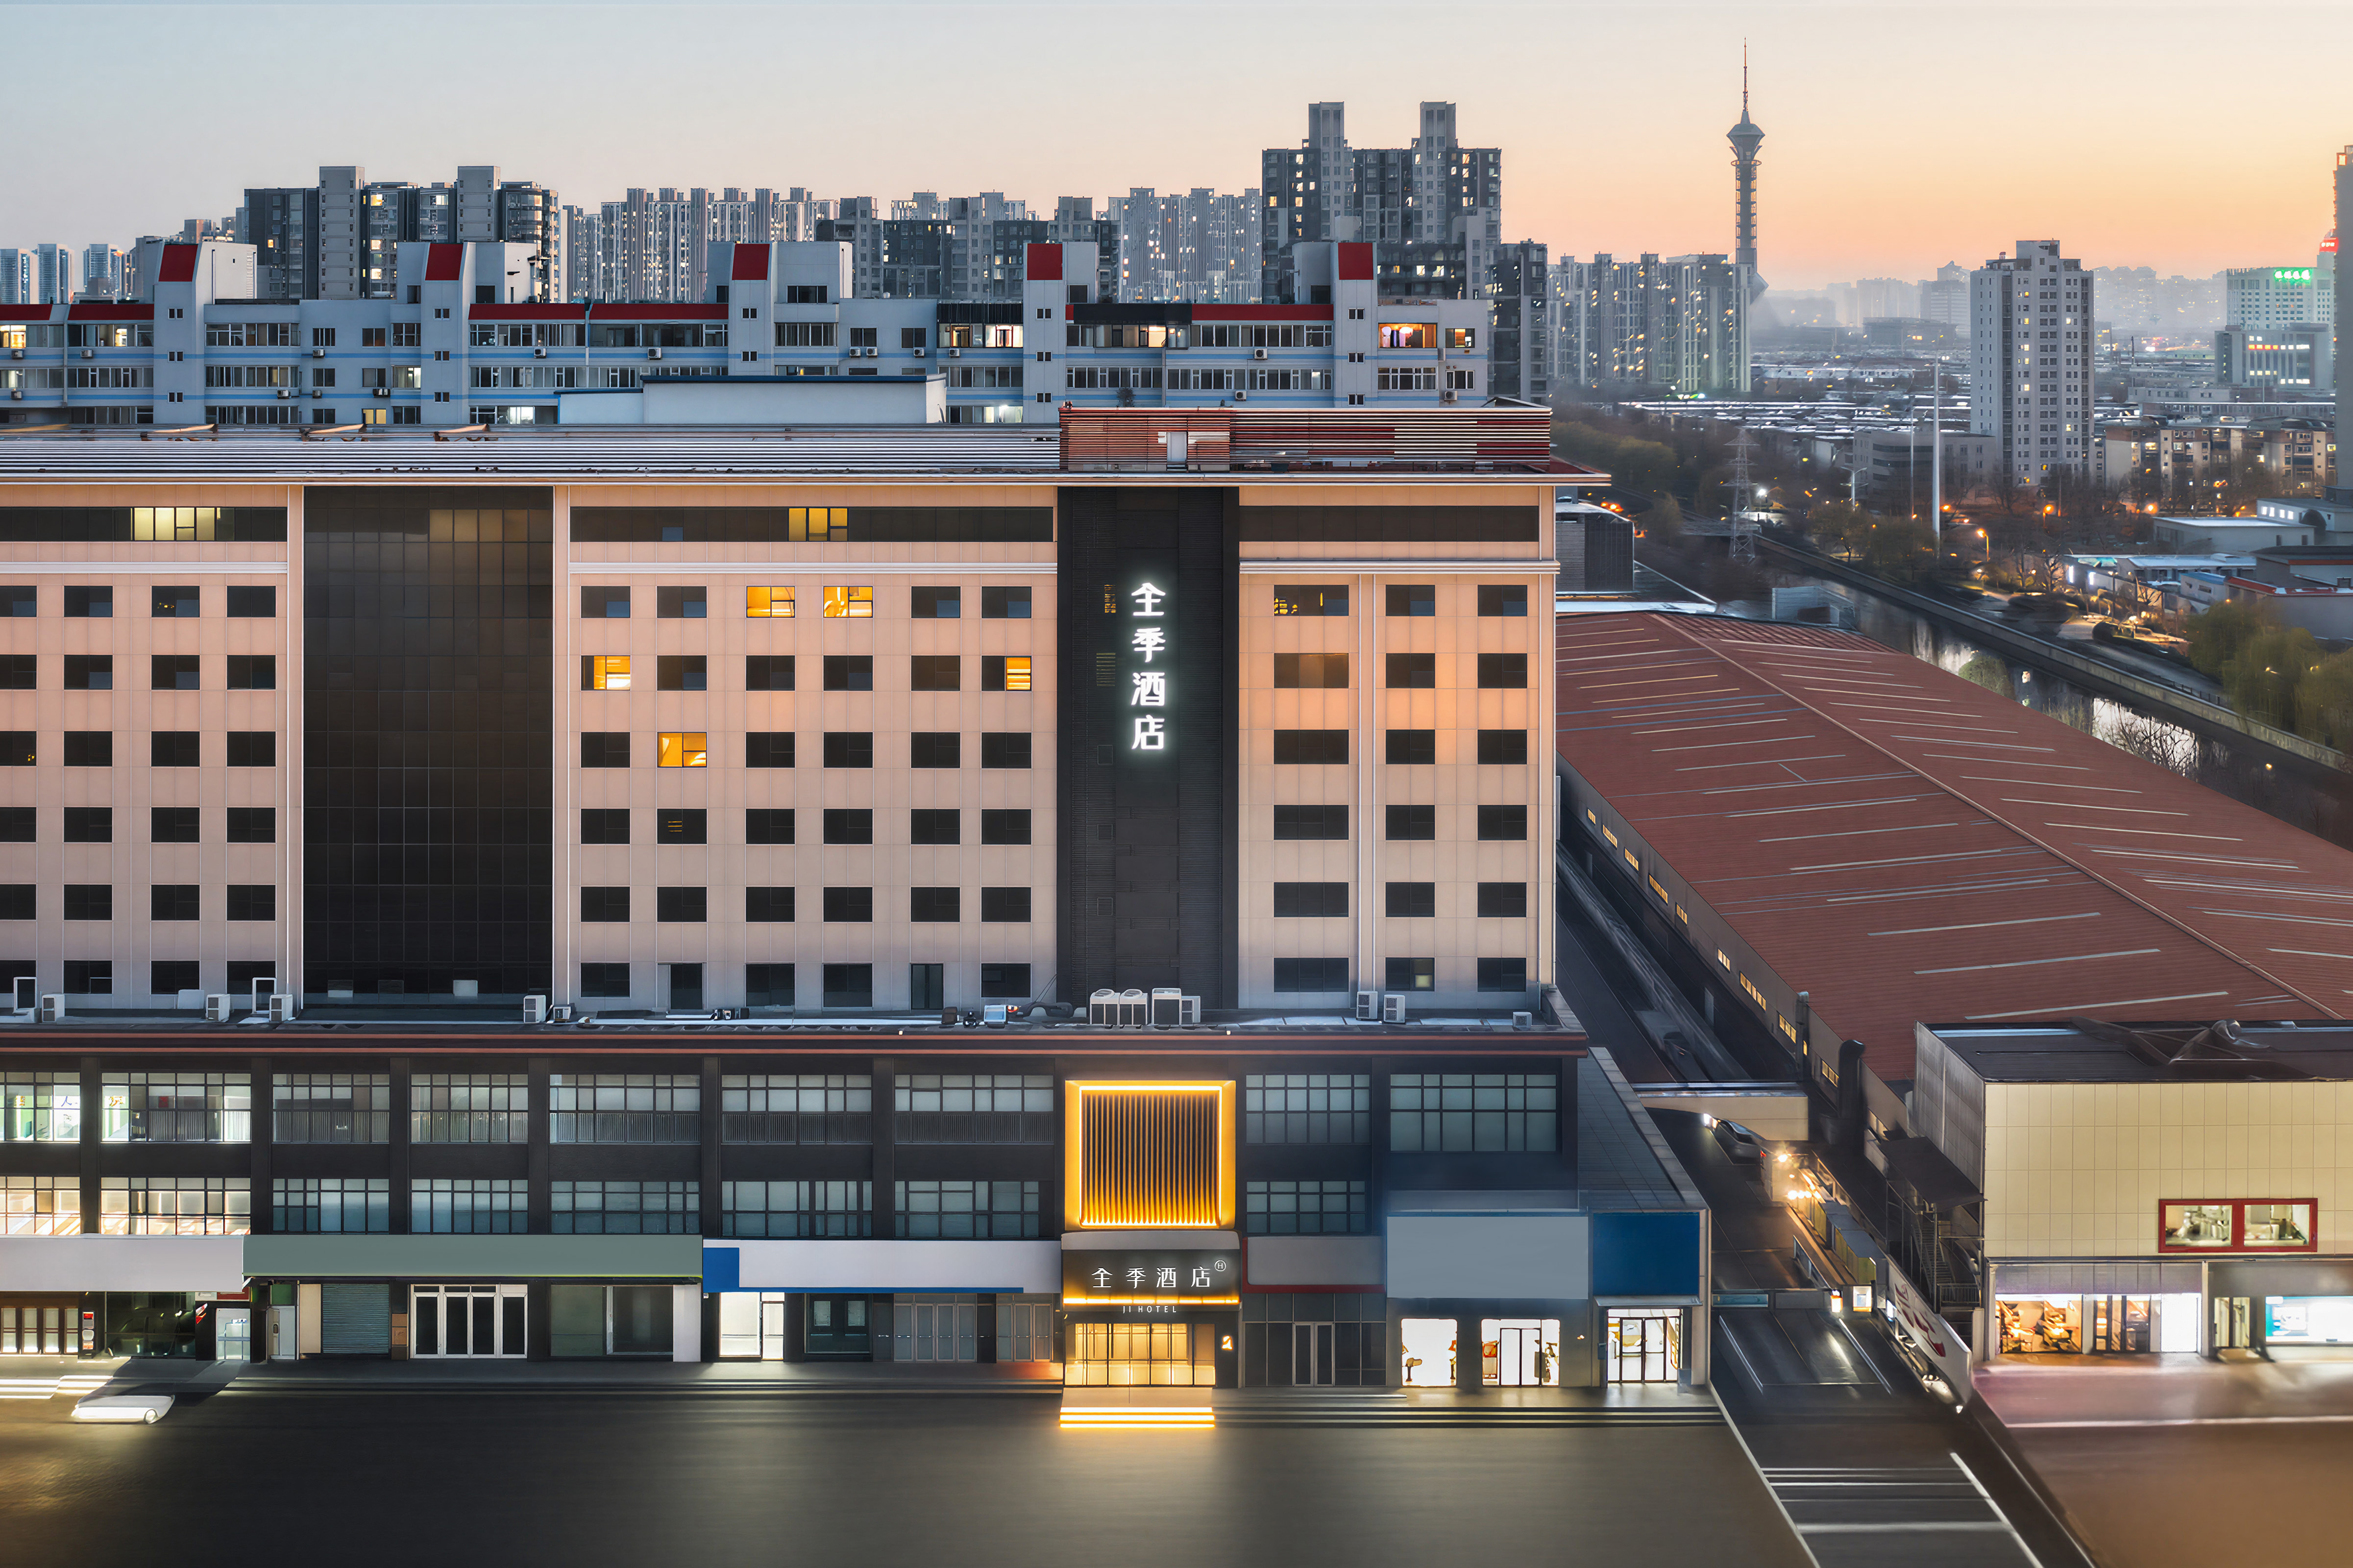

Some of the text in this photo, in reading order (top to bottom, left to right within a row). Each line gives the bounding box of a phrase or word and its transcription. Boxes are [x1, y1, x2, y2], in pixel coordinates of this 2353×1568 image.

[1131, 582, 1166, 750] 全季酒店
[1092, 1267, 1210, 1289] 全季酒店
